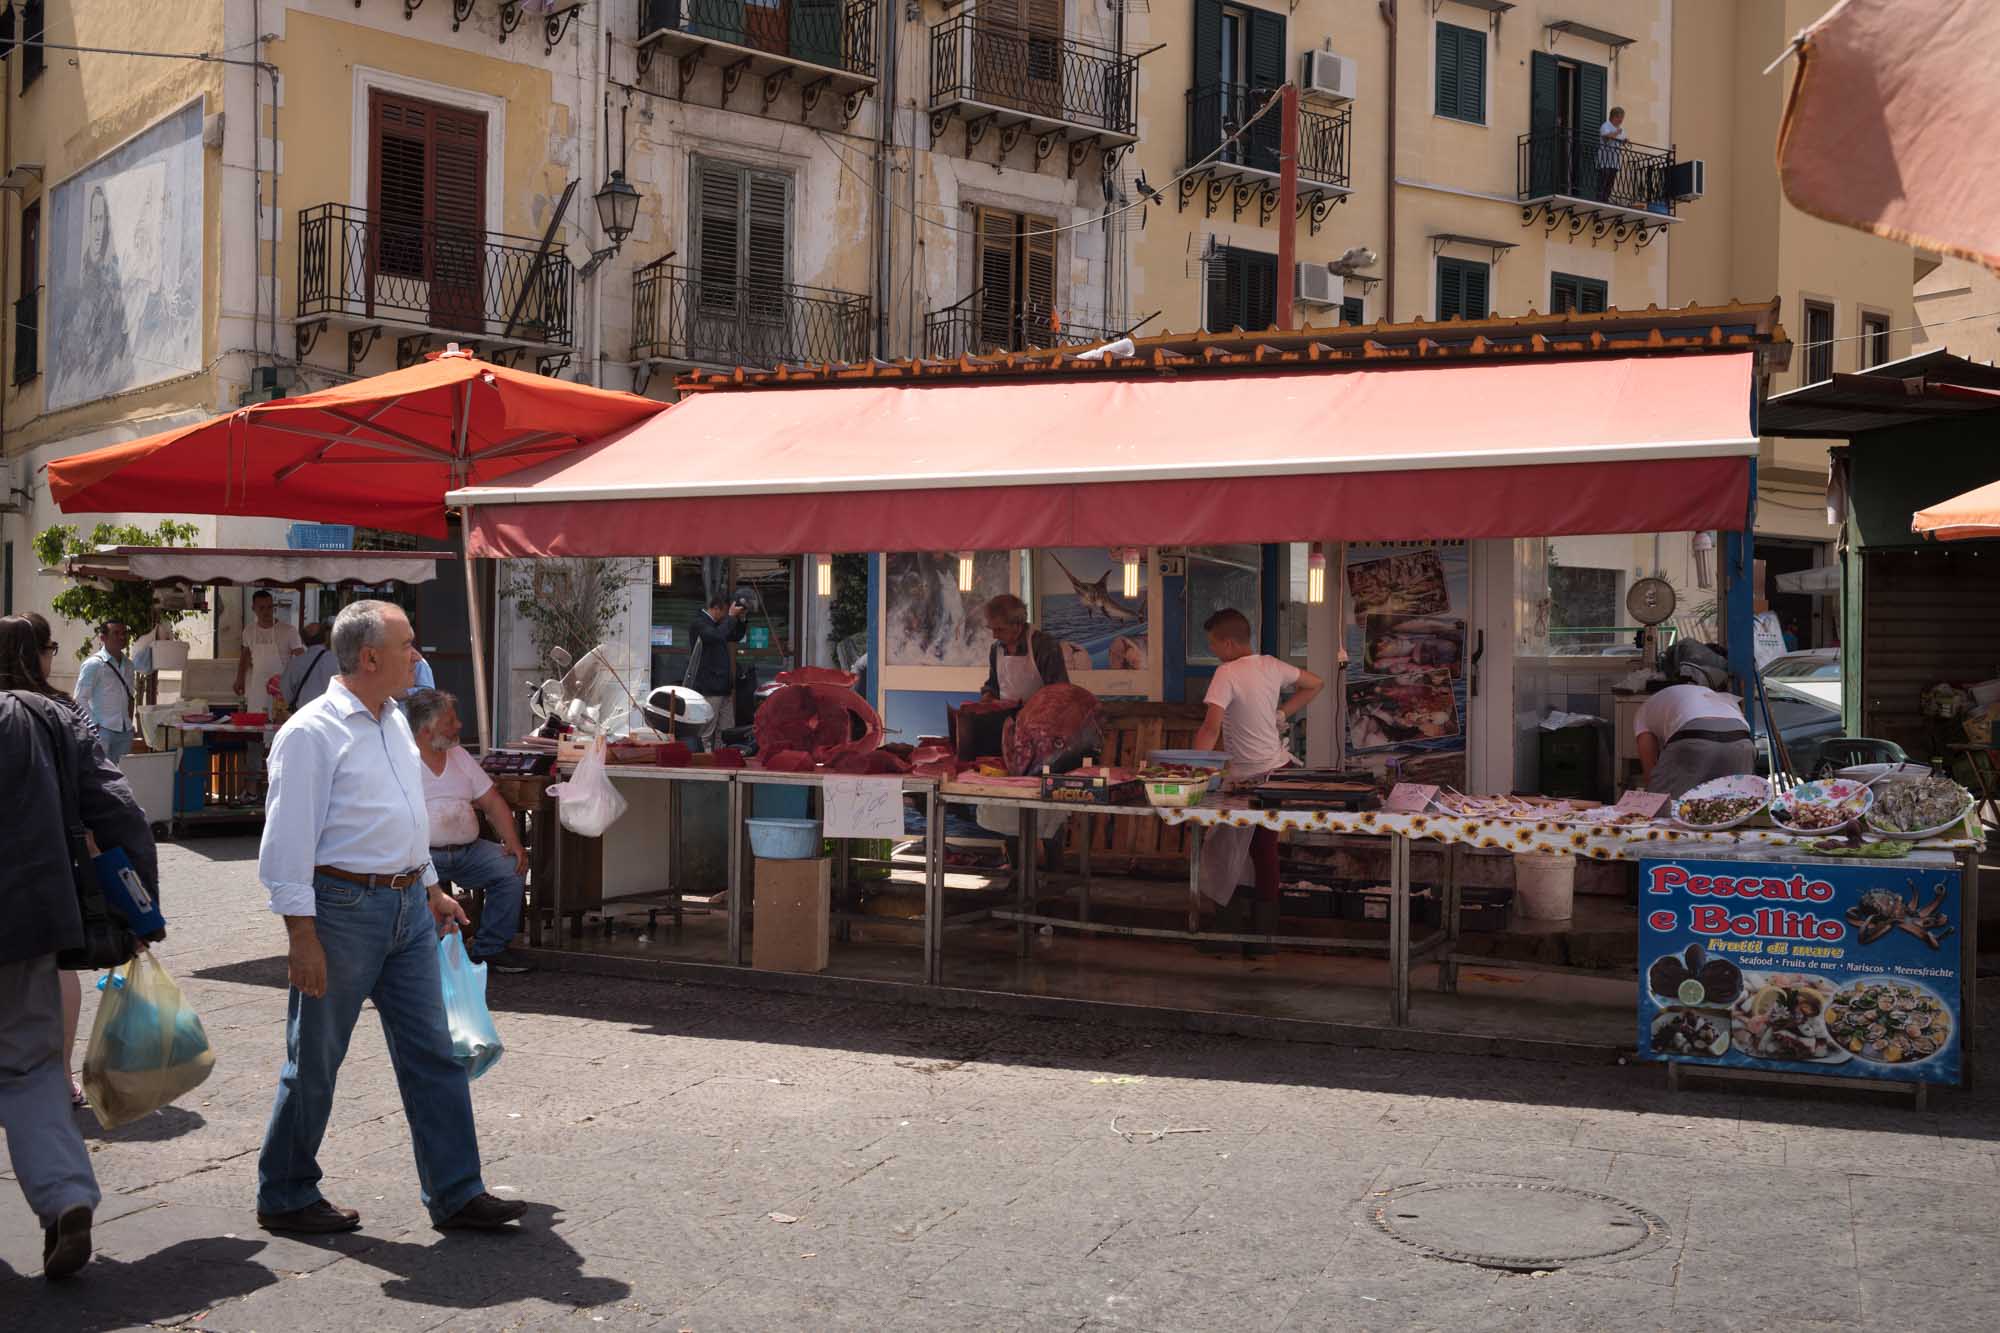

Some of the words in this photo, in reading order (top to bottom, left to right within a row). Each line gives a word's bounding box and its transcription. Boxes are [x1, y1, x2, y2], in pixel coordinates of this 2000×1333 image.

[1649, 865, 1834, 902] Pescato
[1649, 911, 1677, 931] e
[1690, 905, 1845, 941] Bollito
[1707, 938, 1763, 953] Frutti
[1767, 942, 1788, 954] di
[1792, 945, 1844, 958] mare
[1740, 955, 1773, 966] Seafood
[1782, 958, 1806, 968] Fruits
[1808, 959, 1819, 969] de
[1820, 962, 1837, 970] mer
[1847, 962, 1885, 973] Mariscos
[1894, 965, 1955, 978] Meeresfrüchte
